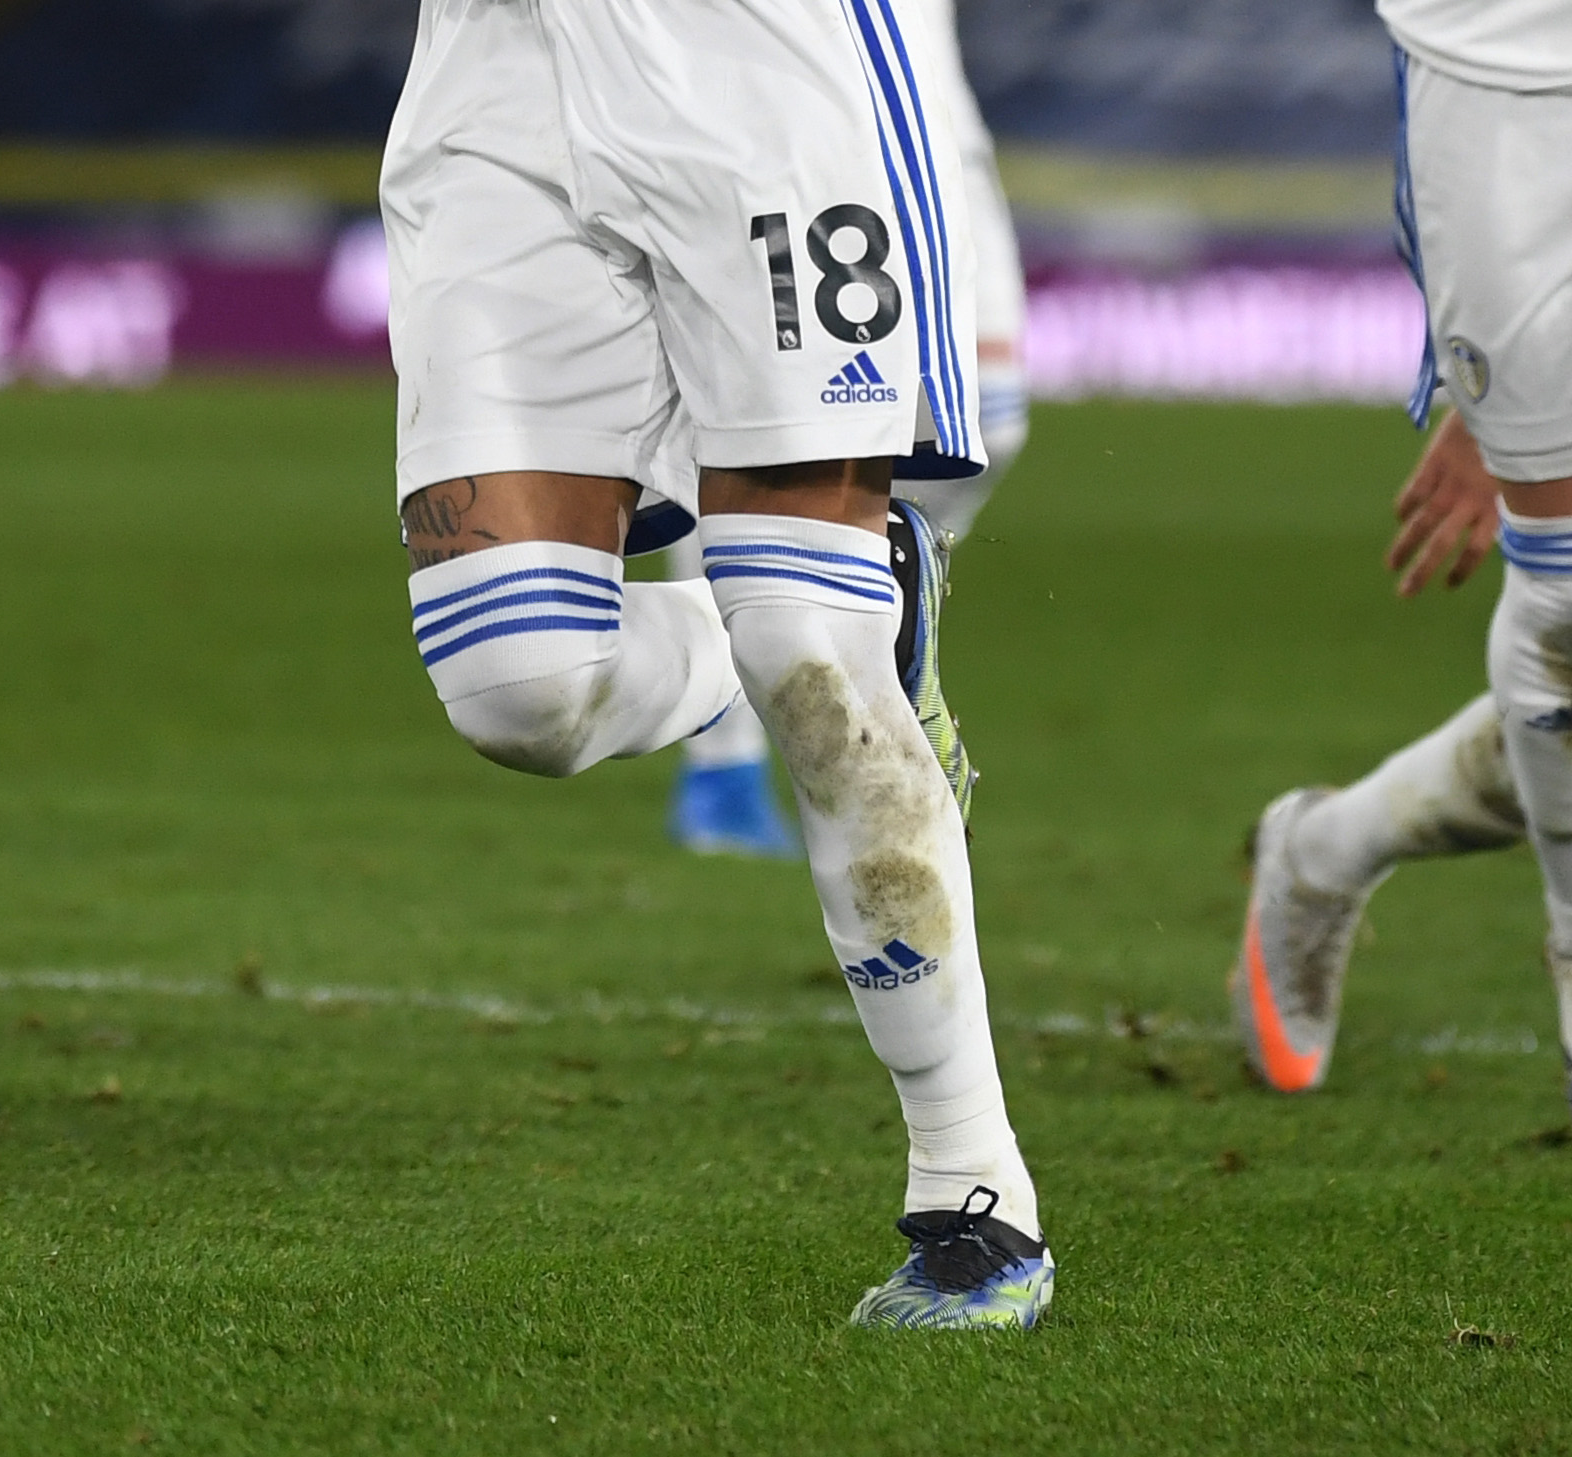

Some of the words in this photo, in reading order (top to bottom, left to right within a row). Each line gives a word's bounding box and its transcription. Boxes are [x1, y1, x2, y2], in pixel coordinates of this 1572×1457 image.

[750, 203, 902, 352] 18
[821, 385, 898, 405] adidas
[842, 957, 939, 991] adidas
